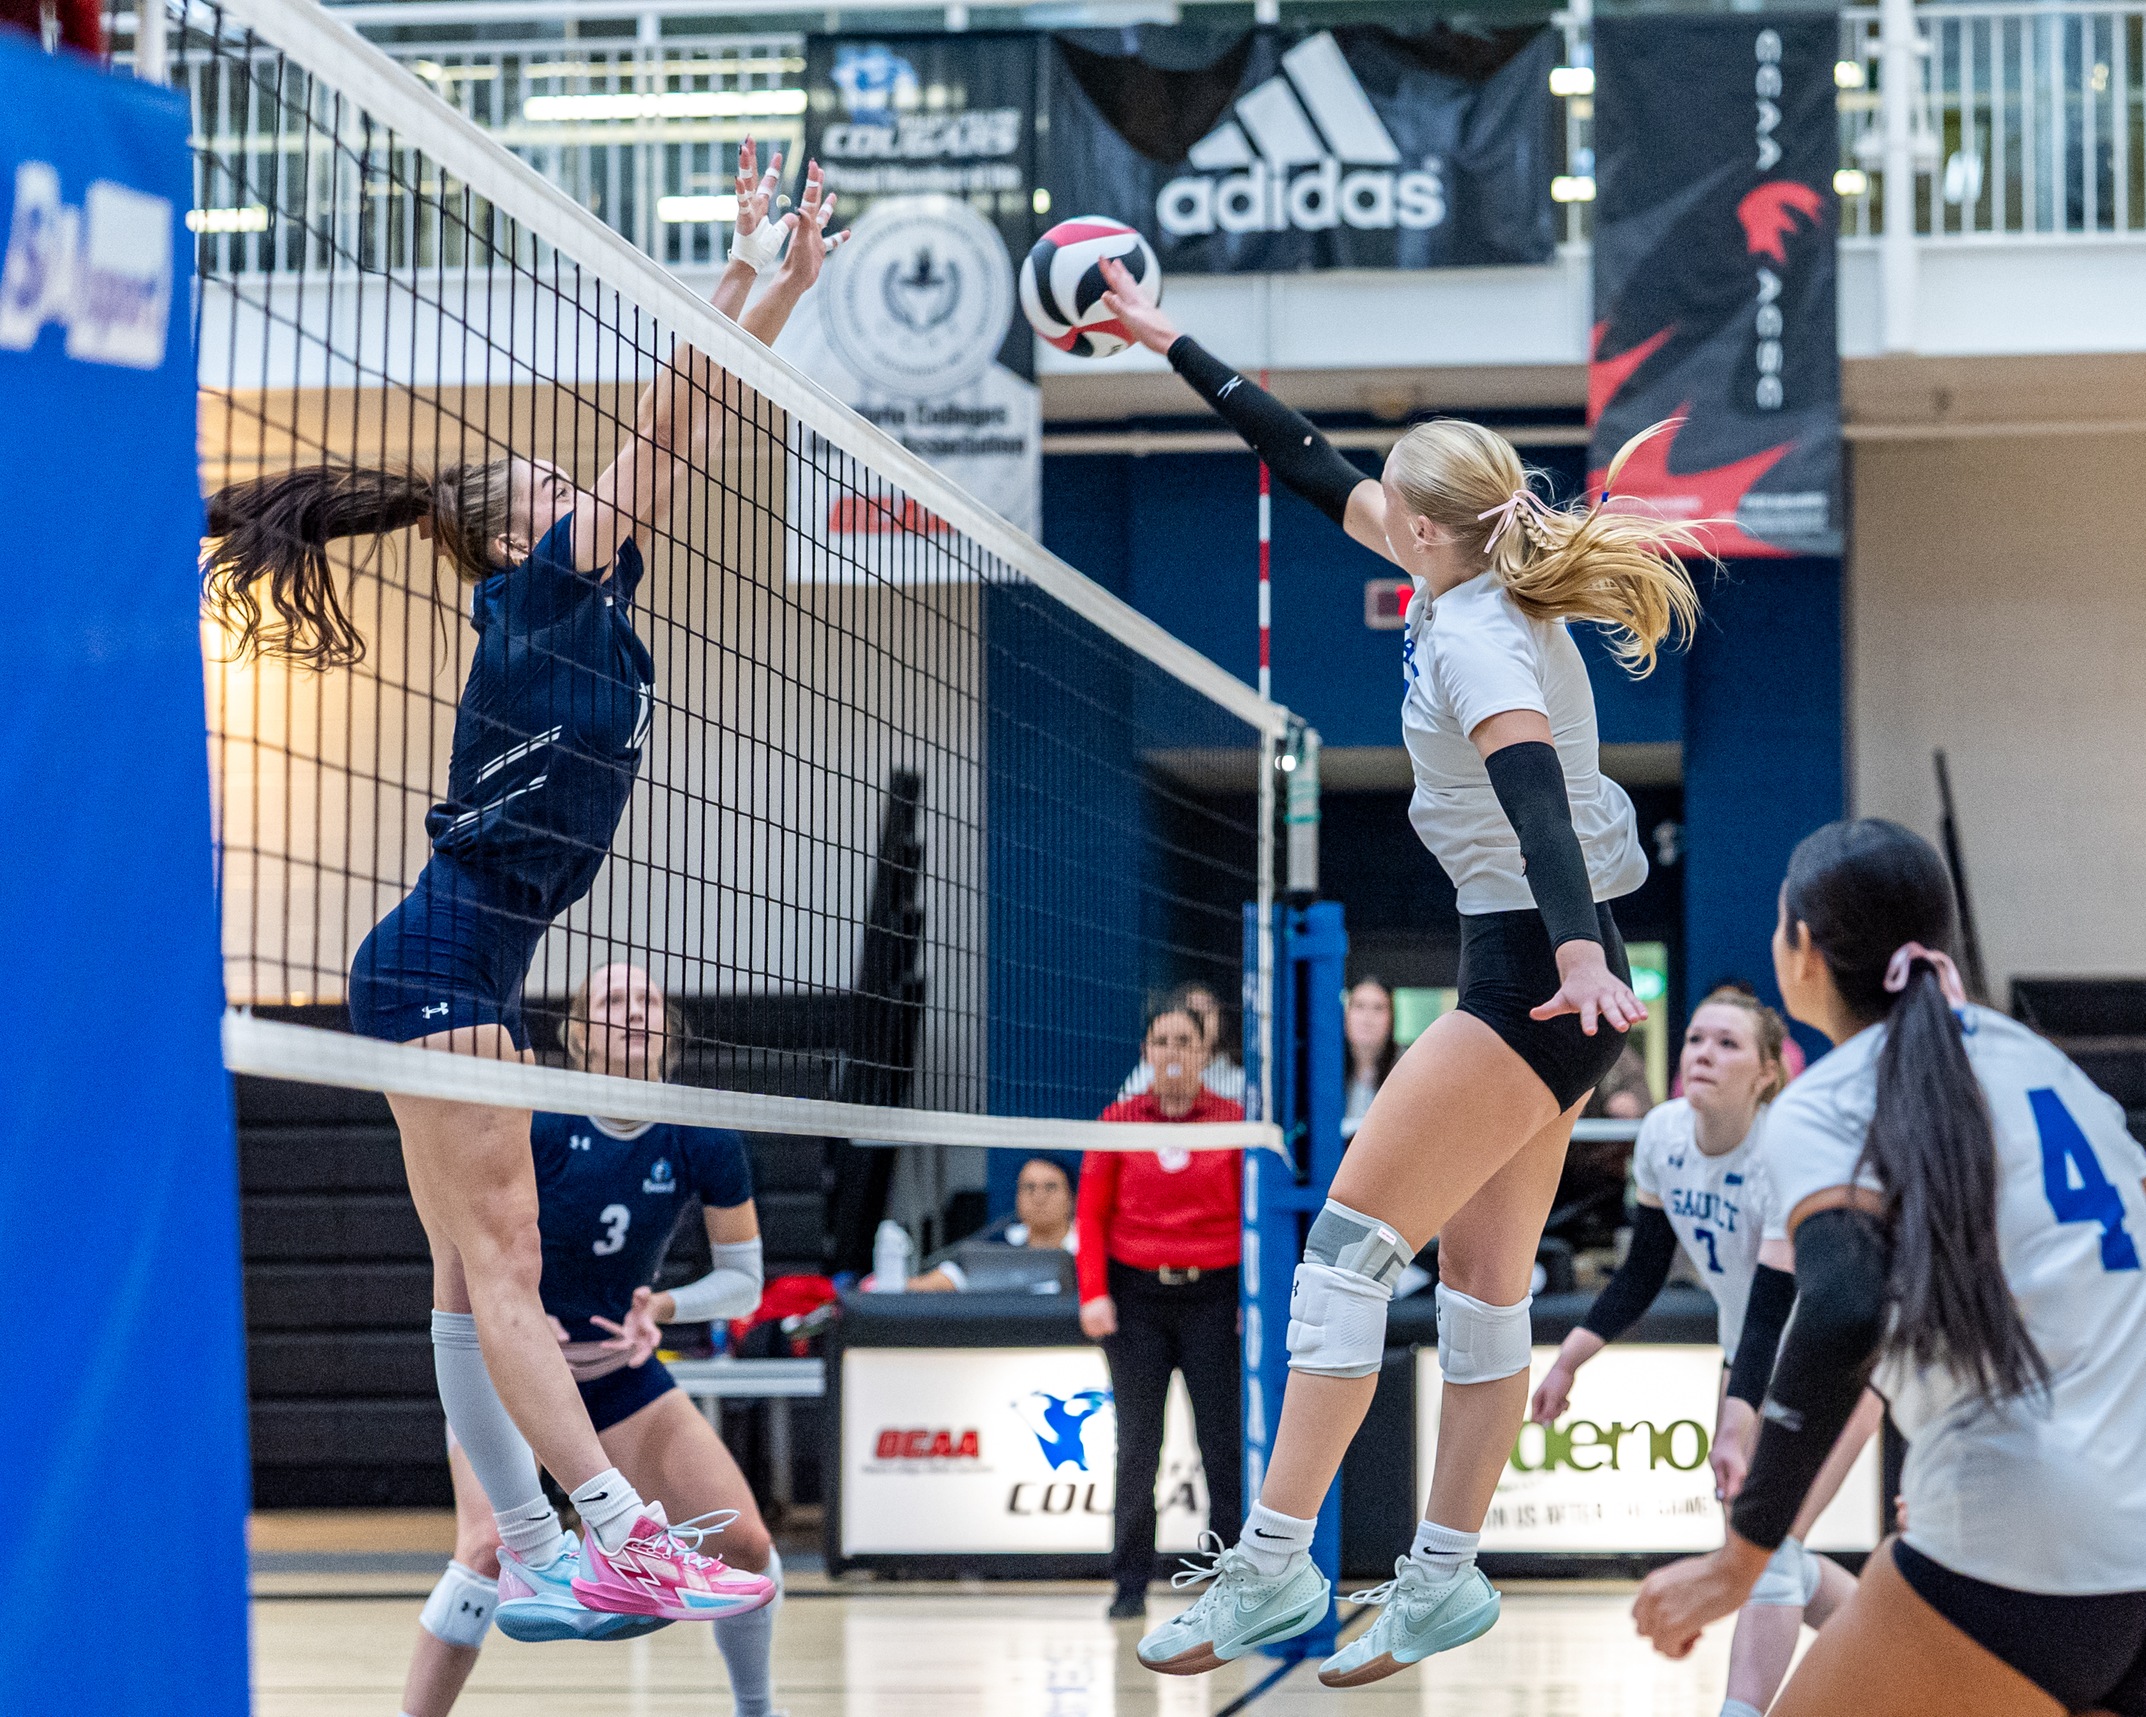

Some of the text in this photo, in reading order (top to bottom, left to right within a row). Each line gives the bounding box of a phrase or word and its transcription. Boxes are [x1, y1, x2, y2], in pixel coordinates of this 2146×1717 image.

[1754, 28, 1783, 171] CCAA
[1156, 157, 1447, 236] adidas
[2026, 1087, 2140, 1271] 4
[592, 1203, 631, 1256] 3
[1671, 1188, 1740, 1232] SAULT
[1694, 1227, 1724, 1273] 7
[875, 1427, 980, 1460] OCAA
[1508, 1420, 1709, 1472] deno
